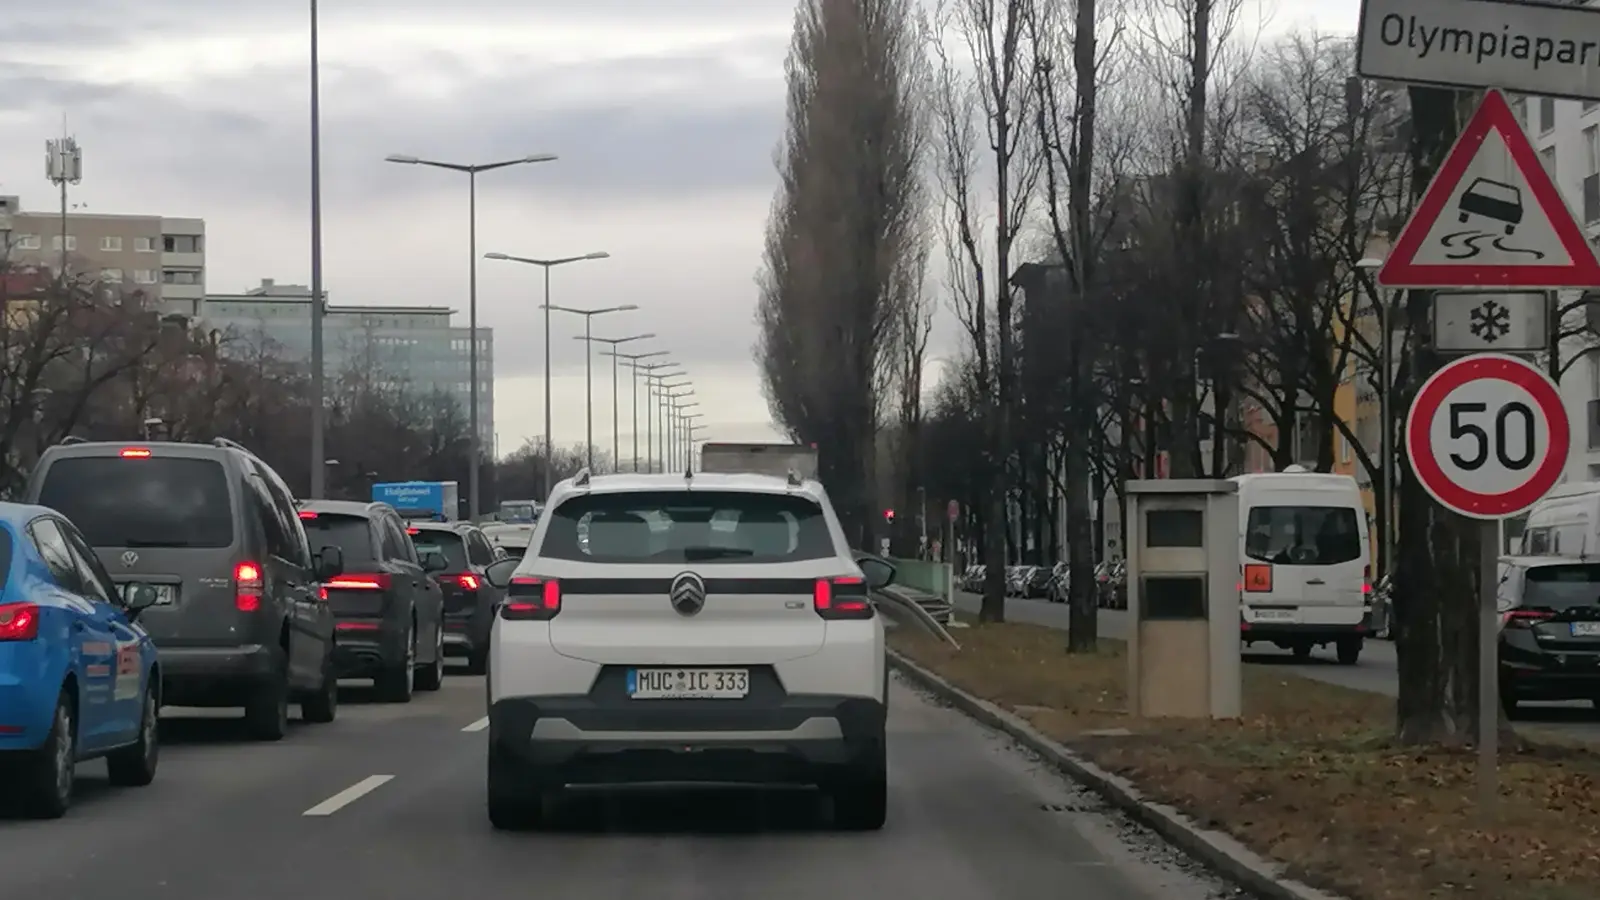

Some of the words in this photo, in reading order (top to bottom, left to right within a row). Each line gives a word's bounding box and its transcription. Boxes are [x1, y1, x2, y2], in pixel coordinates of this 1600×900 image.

[1380, 13, 1600, 70] Olympiapar
[1450, 401, 1535, 470] 50
[639, 672, 672, 691] MUC
[688, 672, 708, 691] IC
[714, 672, 747, 691] 333
